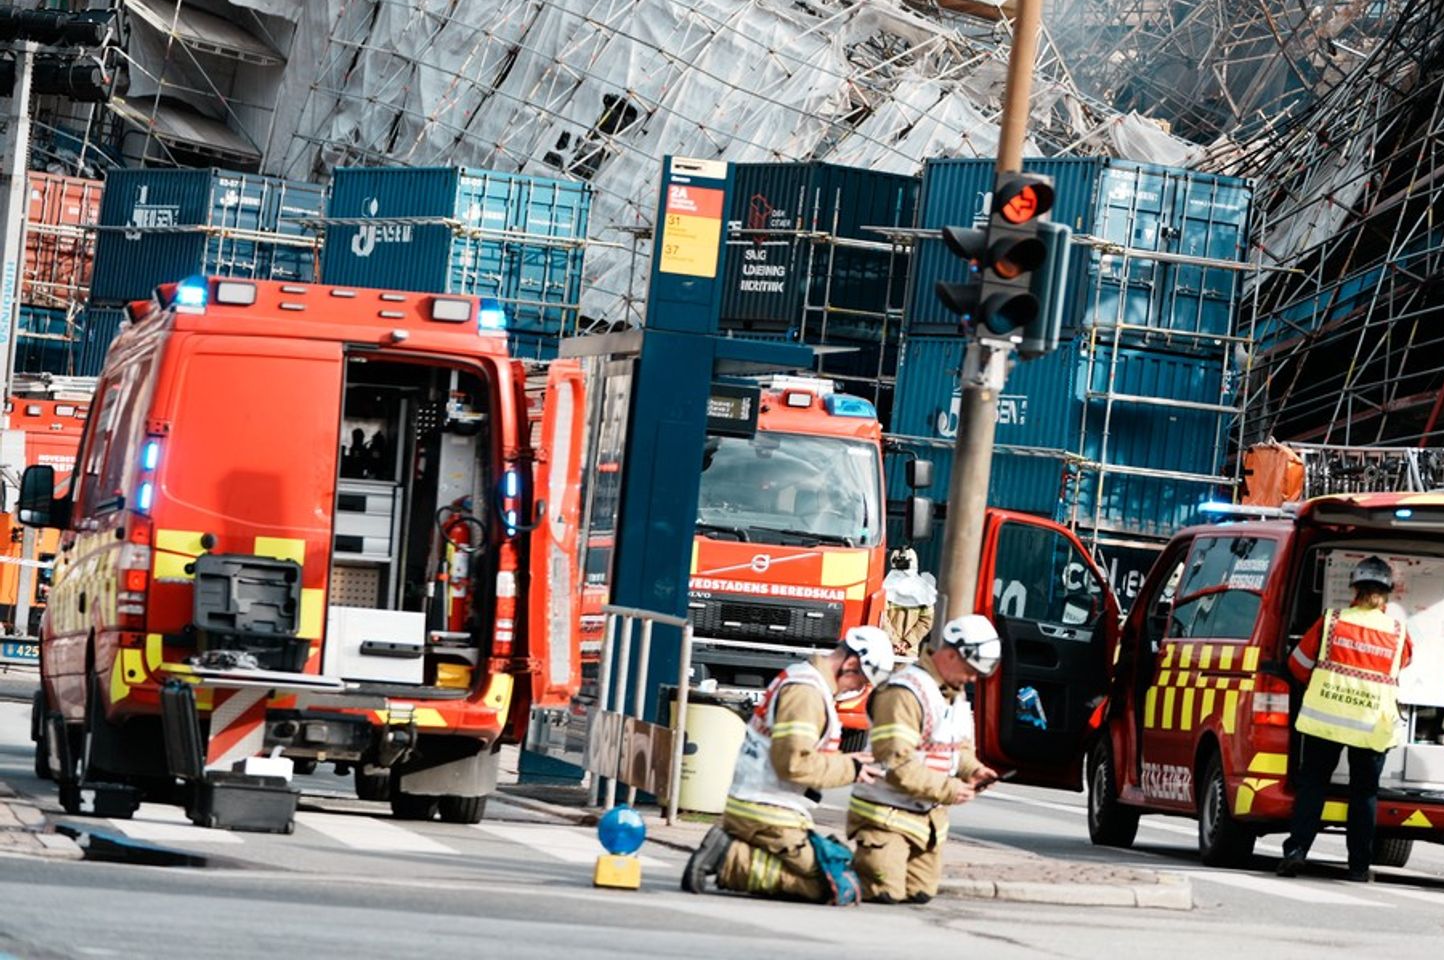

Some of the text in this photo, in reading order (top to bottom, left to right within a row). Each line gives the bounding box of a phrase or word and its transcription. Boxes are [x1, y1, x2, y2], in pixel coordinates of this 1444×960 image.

[668, 215, 681, 226] 31
[664, 243, 680, 255] 37
[770, 584, 846, 601] BEREDSKAB
